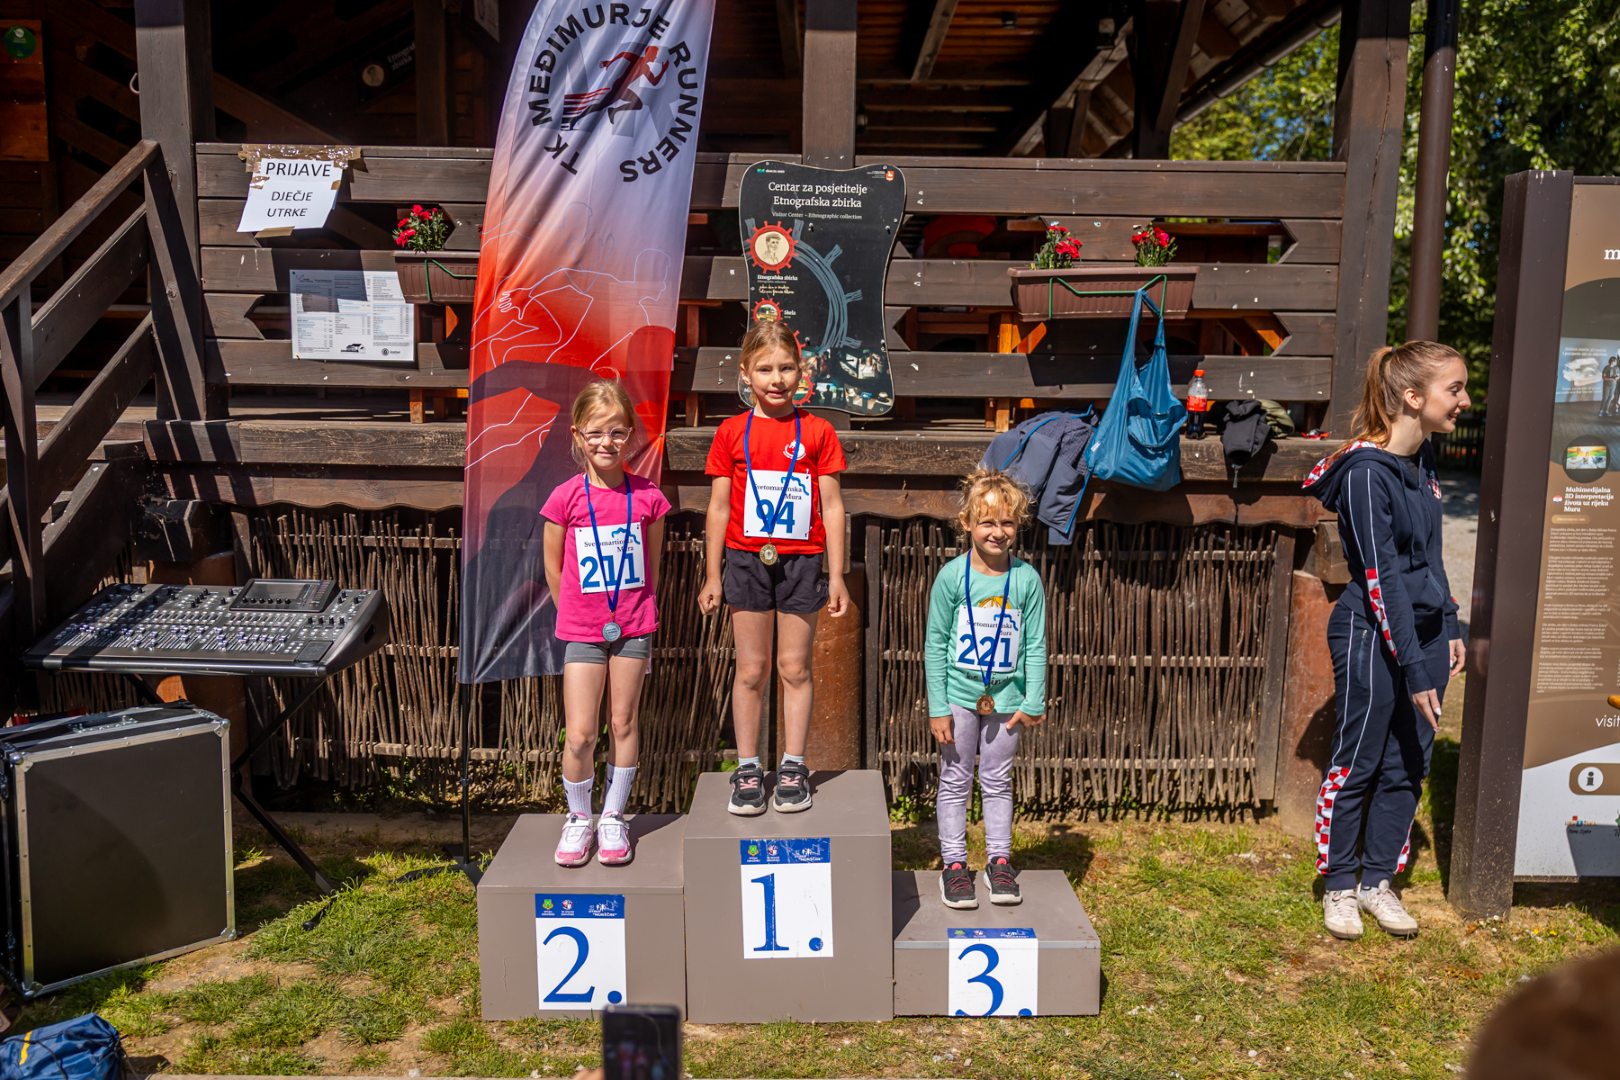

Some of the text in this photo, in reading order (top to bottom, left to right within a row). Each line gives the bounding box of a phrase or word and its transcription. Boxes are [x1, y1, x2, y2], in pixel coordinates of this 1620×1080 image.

[528, 2, 698, 182] TK MEĐIMURJE RUNNERS
[265, 162, 332, 177] PRIJAVE
[271, 190, 313, 202] DJEČJE
[768, 182, 868, 196] Centar za posjetitelje
[773, 195, 862, 209] Etnografska zbirka
[267, 208, 308, 217] UTRKE
[808, 212, 839, 220] Ethnographic
[1565, 486, 1611, 494] Multimedijalna
[1574, 493, 1614, 501] interpretacija
[756, 499, 795, 533] 94
[580, 553, 640, 588] 211
[957, 633, 1013, 668] 221
[751, 873, 824, 951] 1.
[543, 926, 622, 1004] 2.
[955, 943, 1032, 1016] 3.
